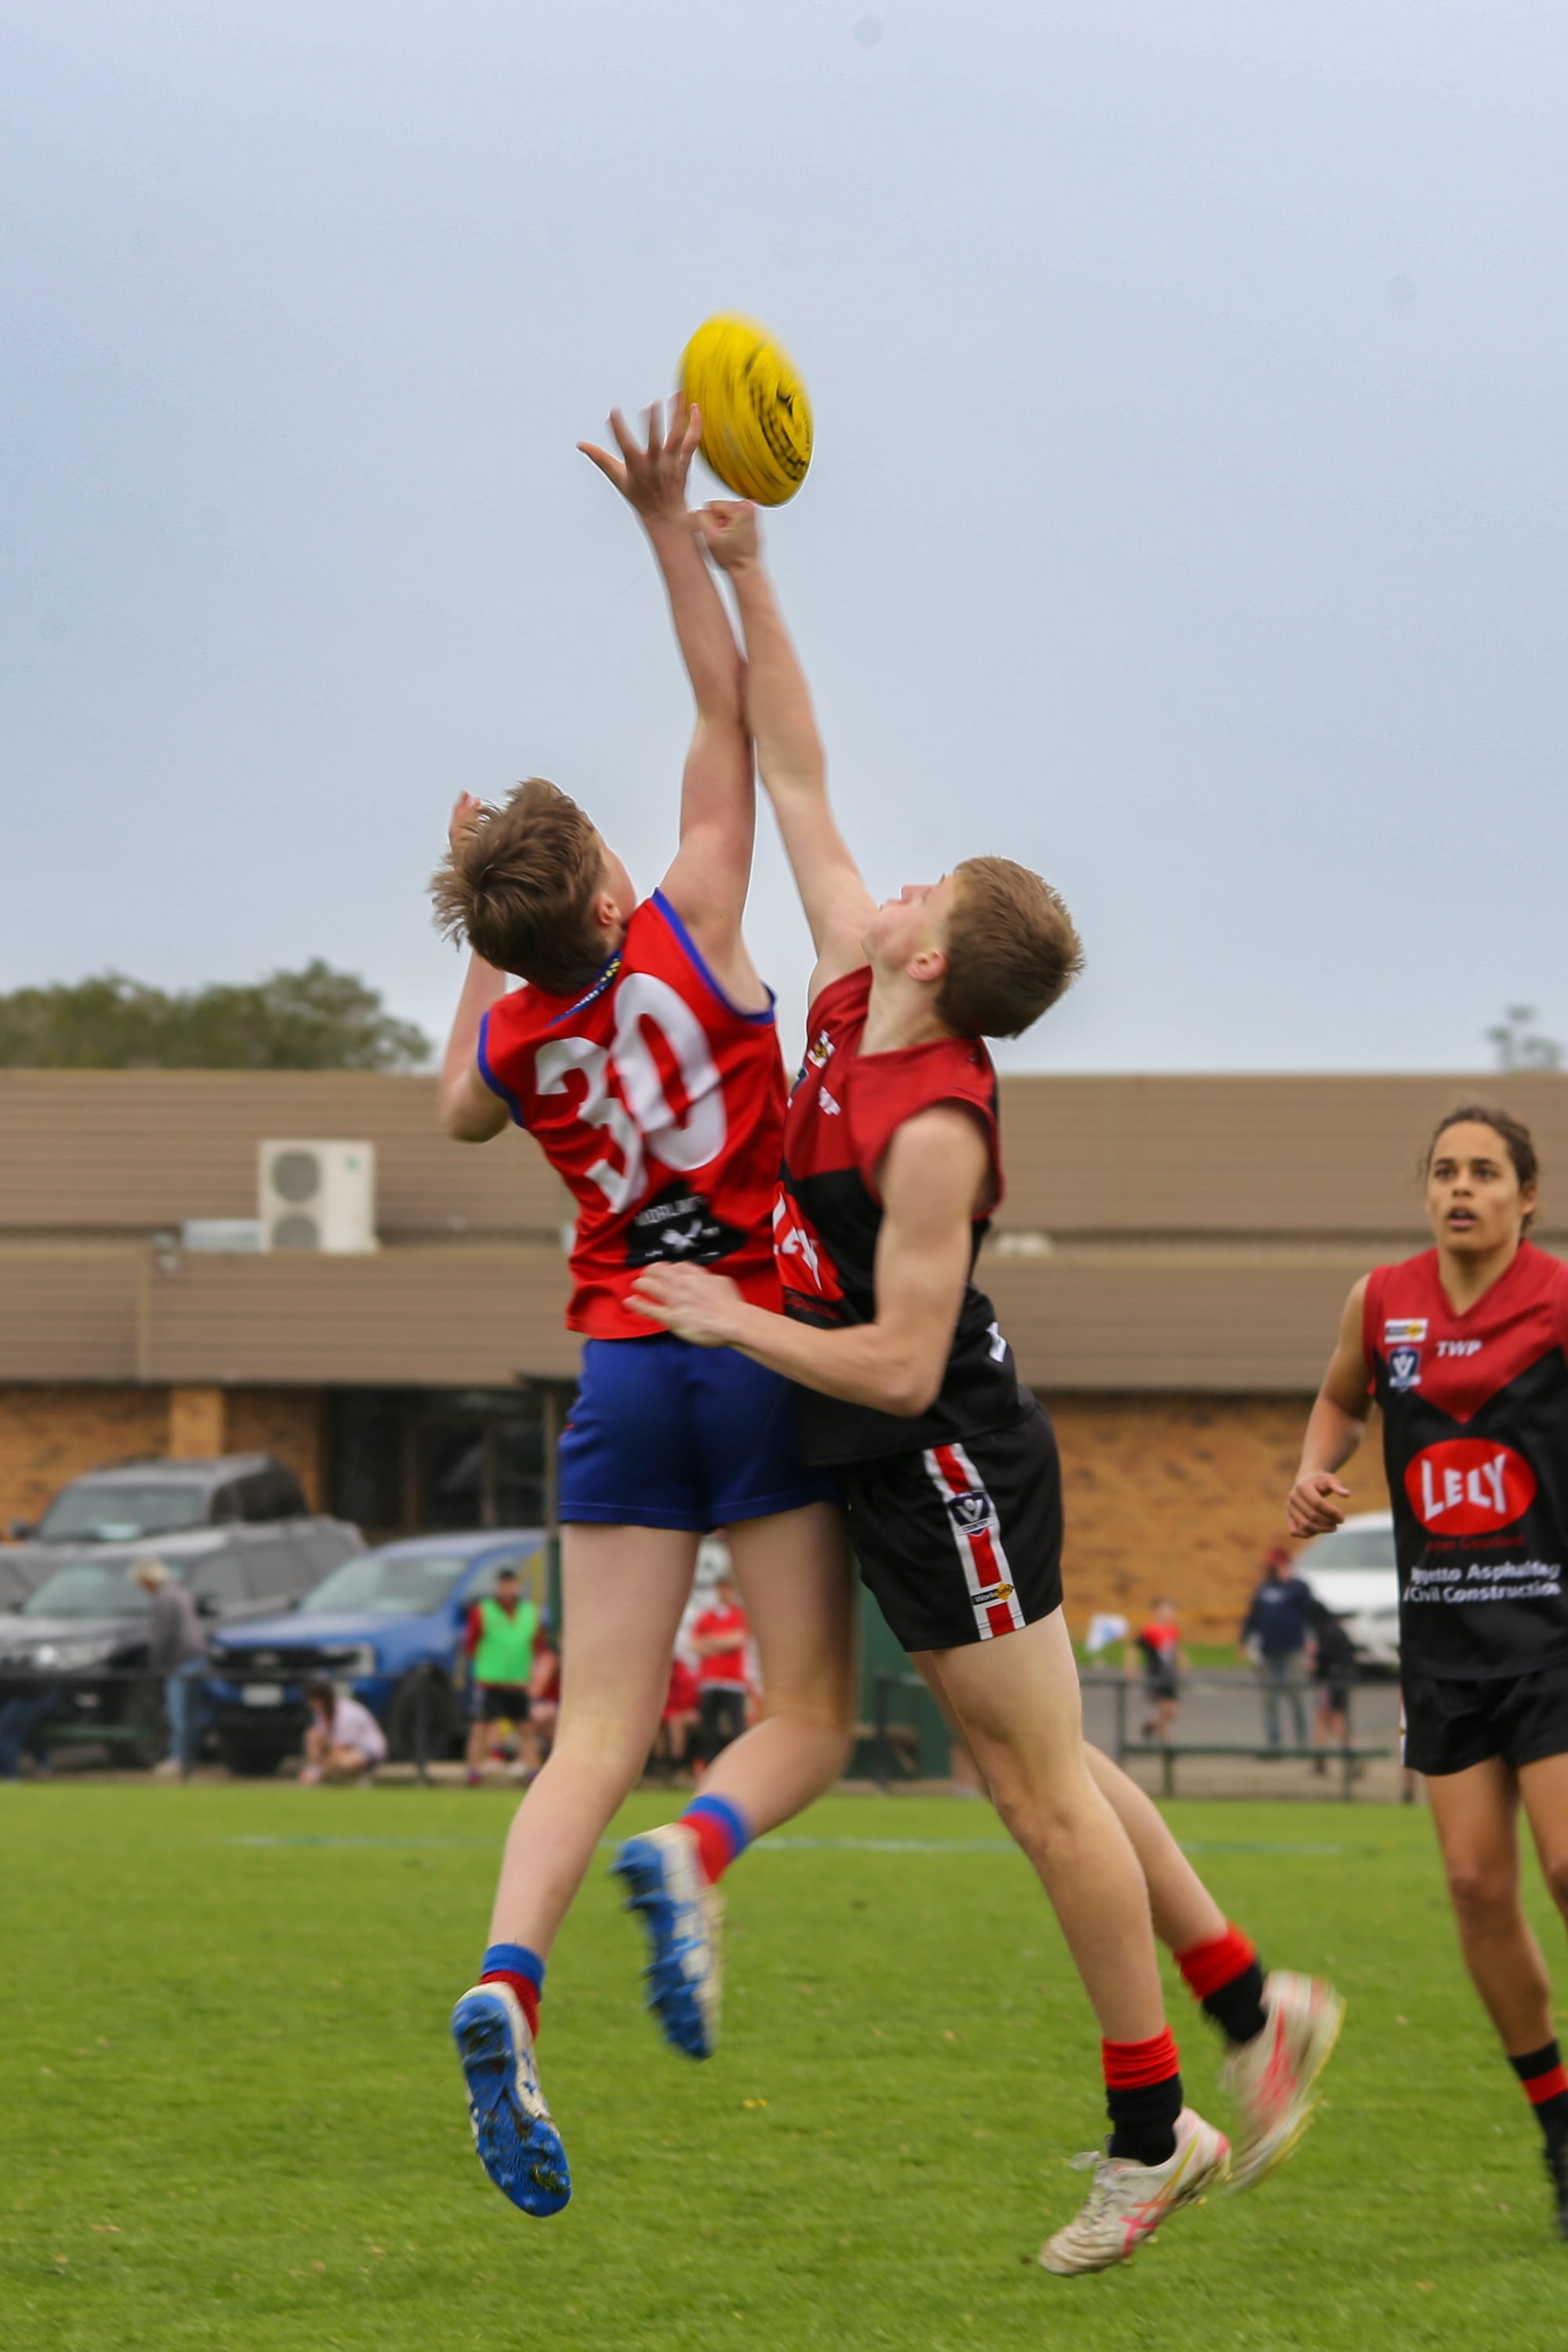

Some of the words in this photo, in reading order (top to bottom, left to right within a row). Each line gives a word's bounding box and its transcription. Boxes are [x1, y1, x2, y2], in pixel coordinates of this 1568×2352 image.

[535, 972, 727, 1214] 30
[1436, 1339, 1483, 1358] TWP
[1421, 1453, 1507, 1521] LELY
